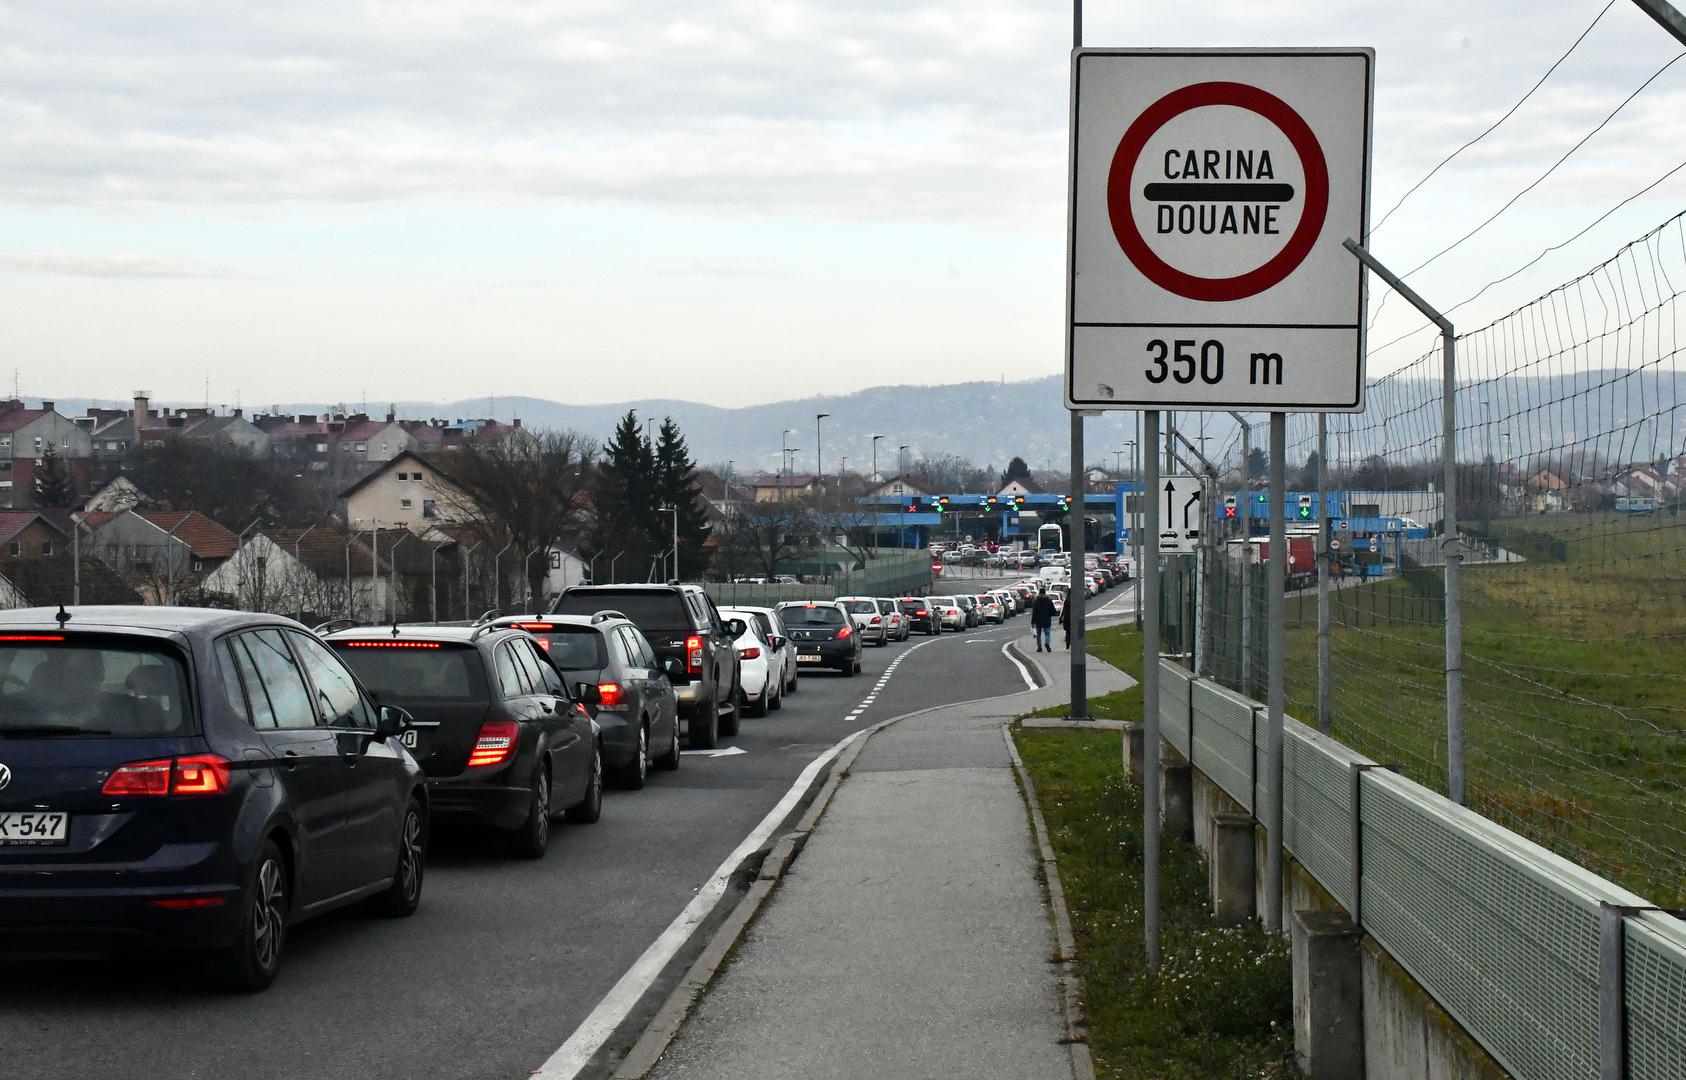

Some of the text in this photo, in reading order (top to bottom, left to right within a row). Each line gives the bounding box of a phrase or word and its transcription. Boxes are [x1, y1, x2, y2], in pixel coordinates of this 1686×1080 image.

[1164, 149, 1275, 180] CARINA
[1157, 204, 1281, 235] DOUANE
[1144, 338, 1283, 386] 350 m
